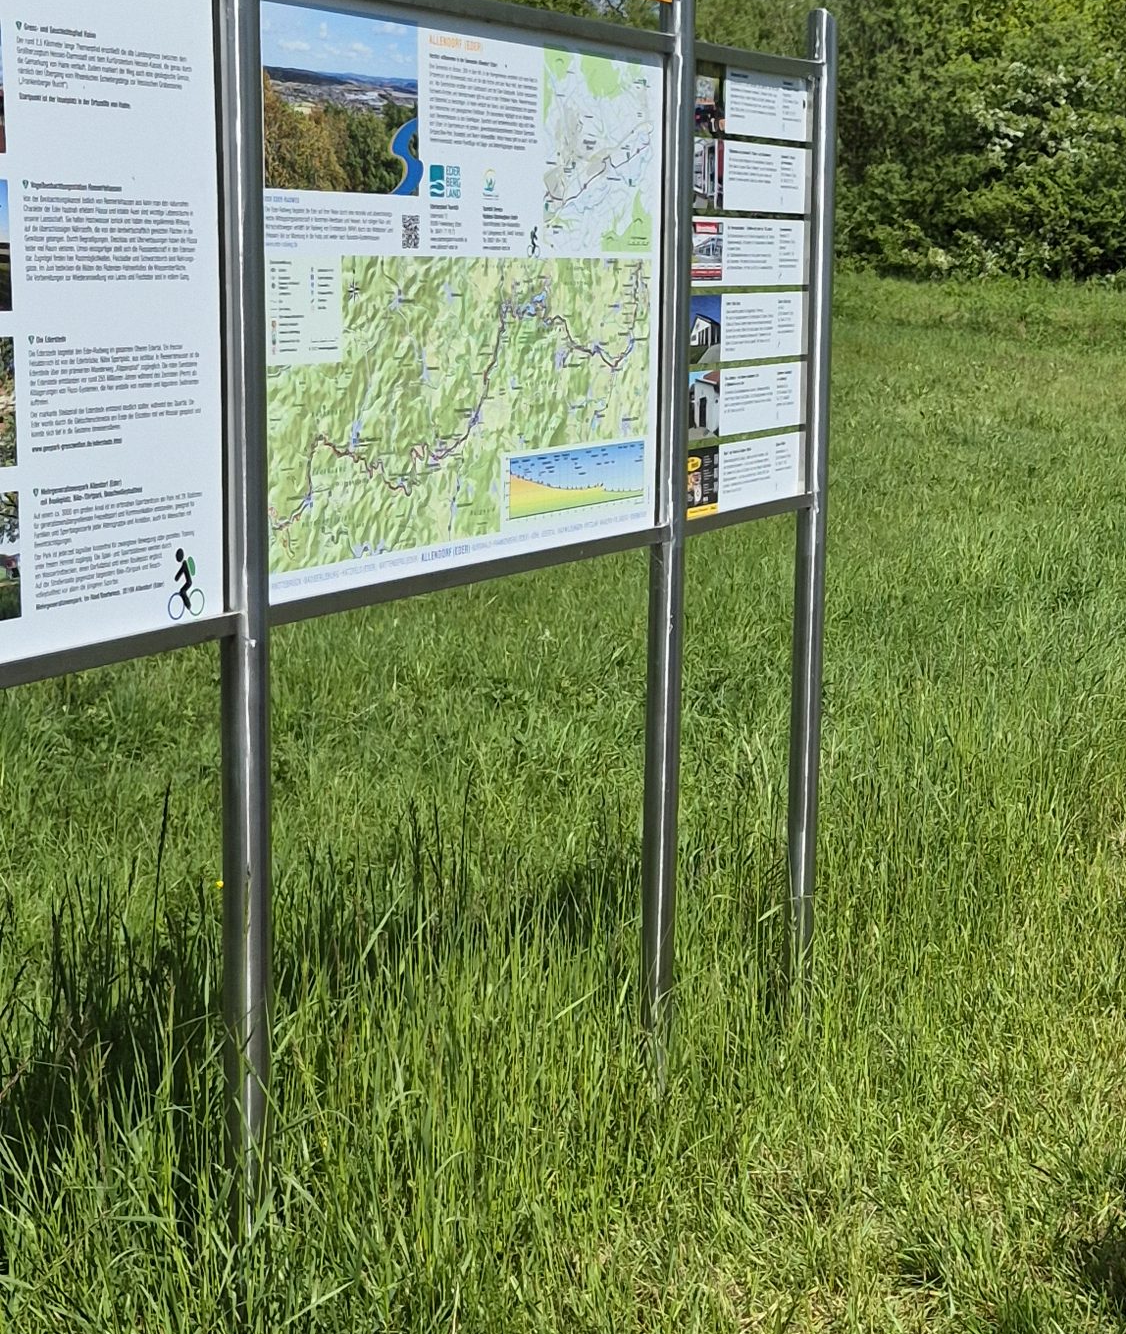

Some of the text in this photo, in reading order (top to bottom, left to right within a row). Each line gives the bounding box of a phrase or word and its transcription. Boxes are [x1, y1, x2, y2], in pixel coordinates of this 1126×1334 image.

[446, 165, 461, 176] EDER
[446, 177, 461, 188] BERG
[446, 188, 461, 199] LAND
[421, 549, 452, 562] ALLENDORF
